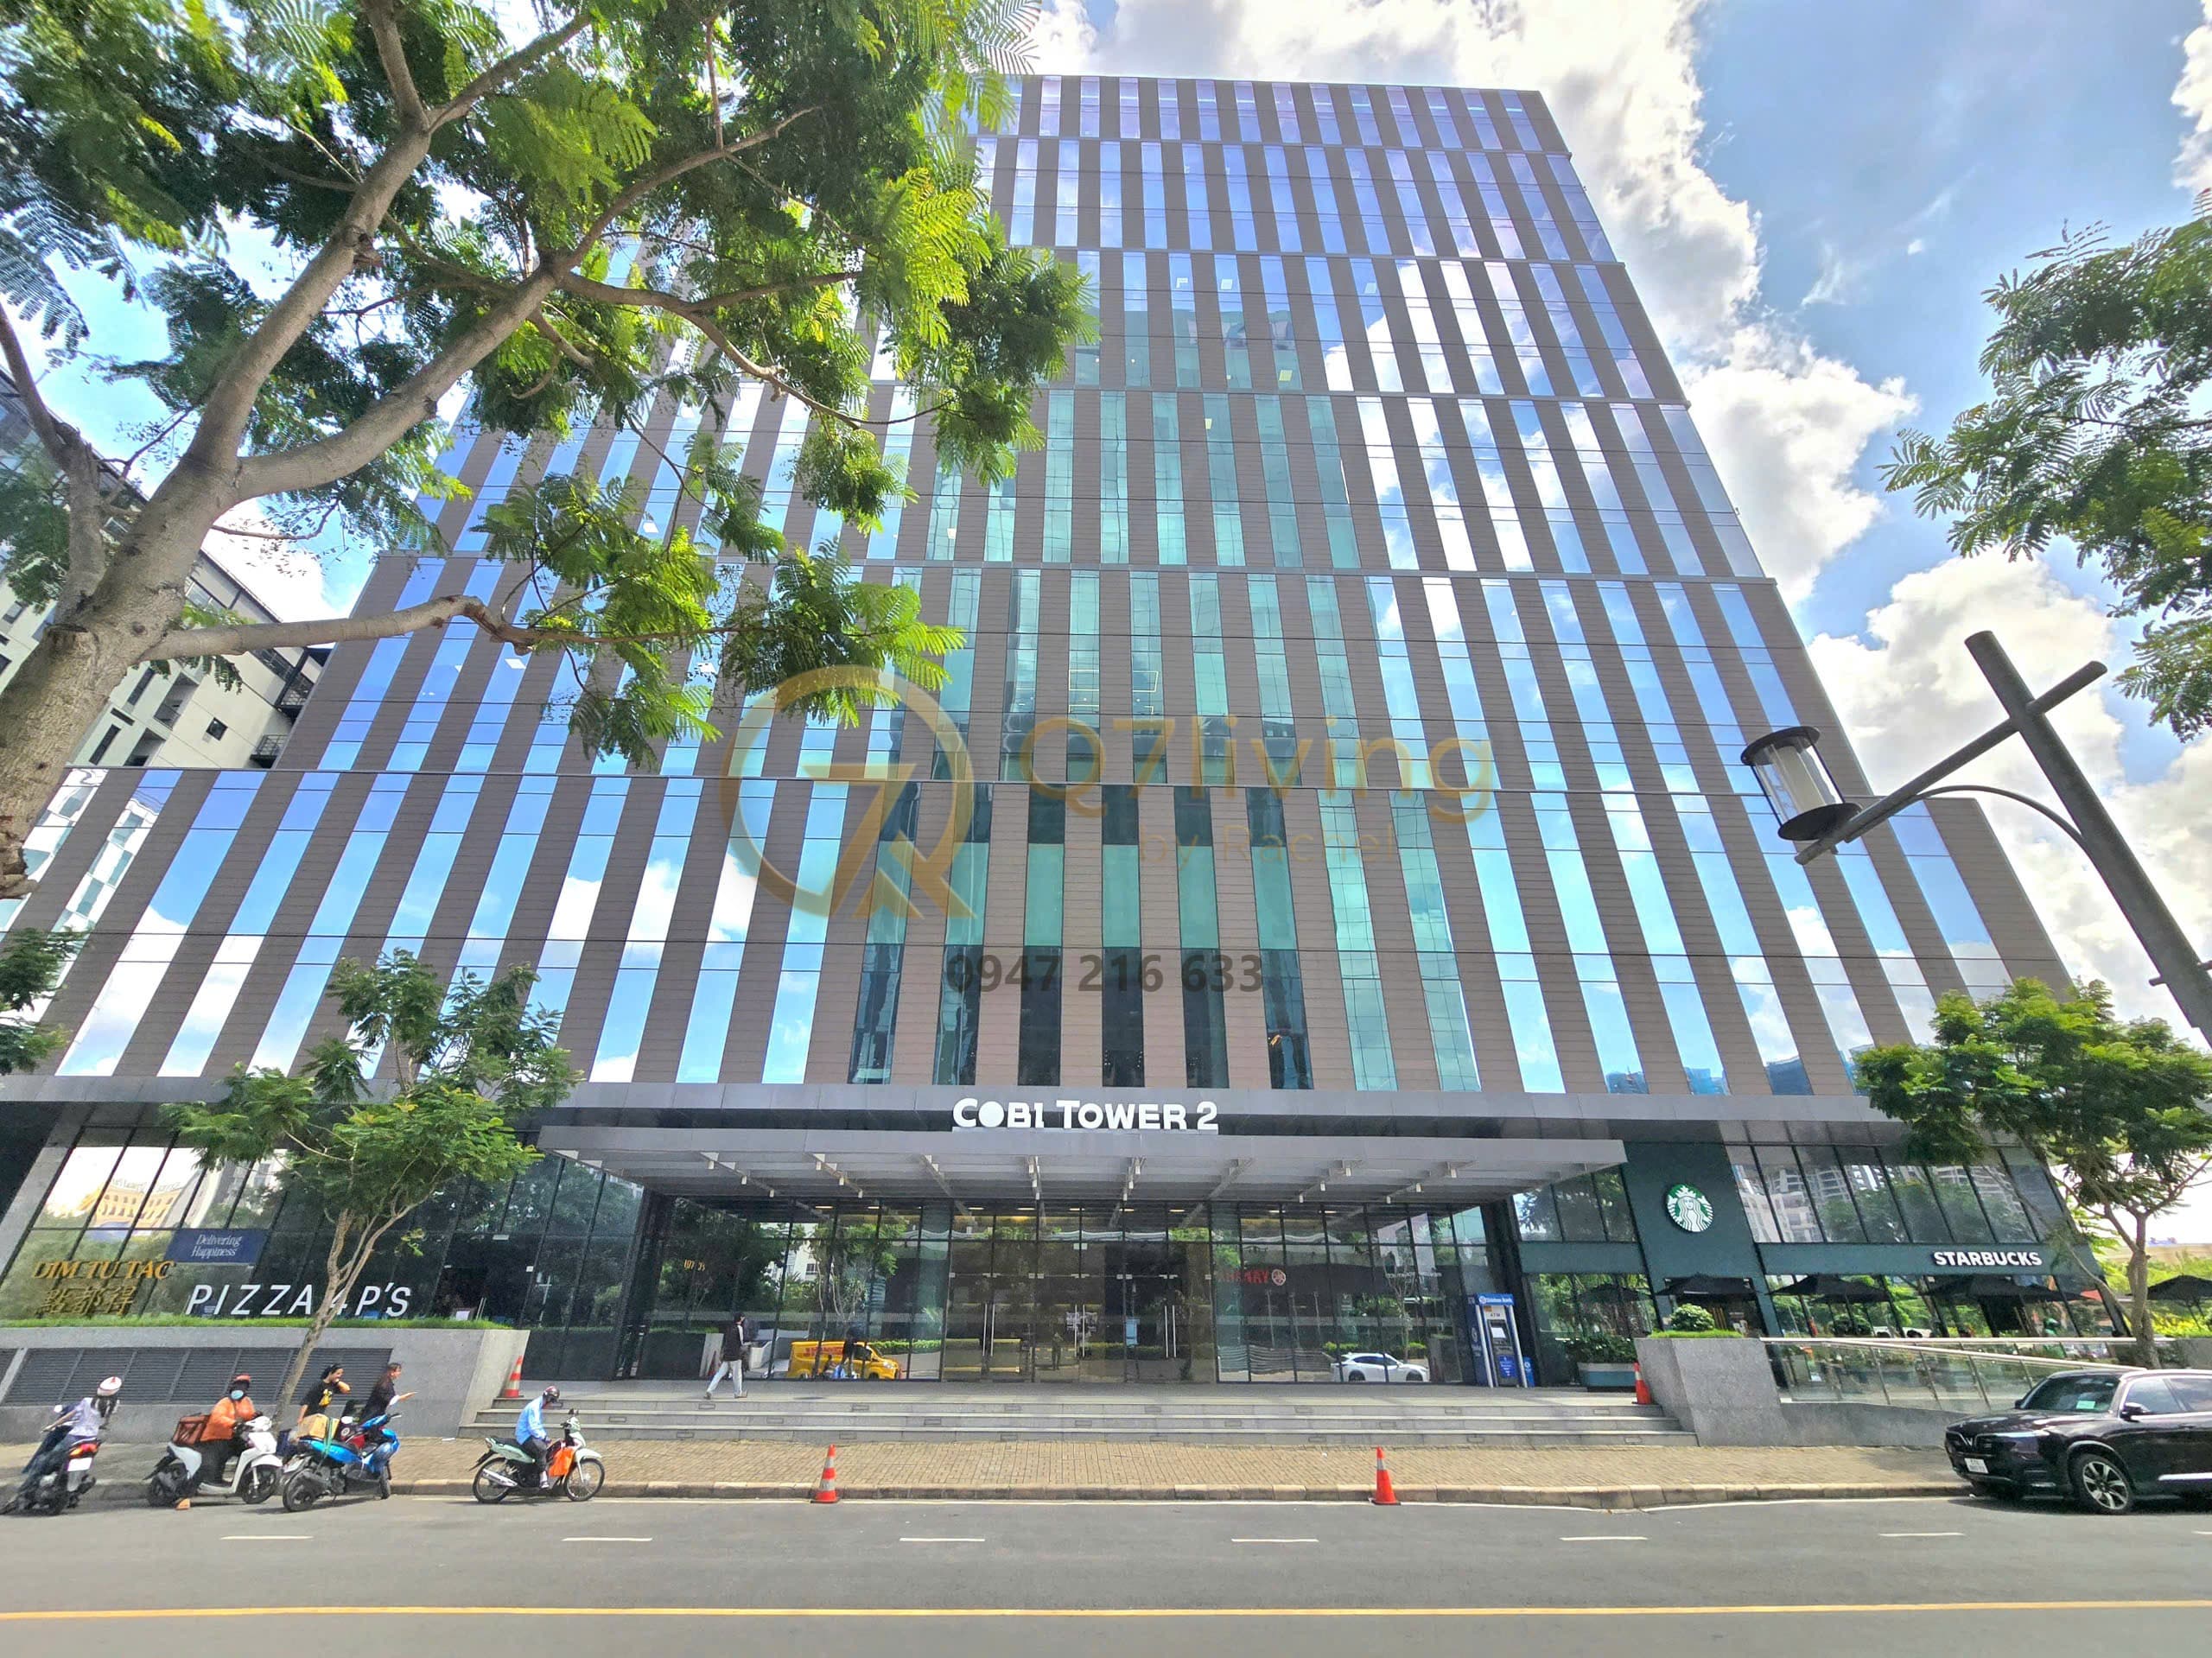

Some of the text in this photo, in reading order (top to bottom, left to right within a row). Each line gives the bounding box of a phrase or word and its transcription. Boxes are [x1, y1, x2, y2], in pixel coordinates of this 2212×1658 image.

[952, 1097, 1218, 1131] COBI TOWER 2
[196, 1234, 242, 1248] Delivering
[191, 1245, 237, 1259] Happiness
[1933, 1251, 2043, 1266] STARBUCKS
[33, 1260, 176, 1280] DIM TU TAC
[185, 1284, 313, 1316] PIZZA
